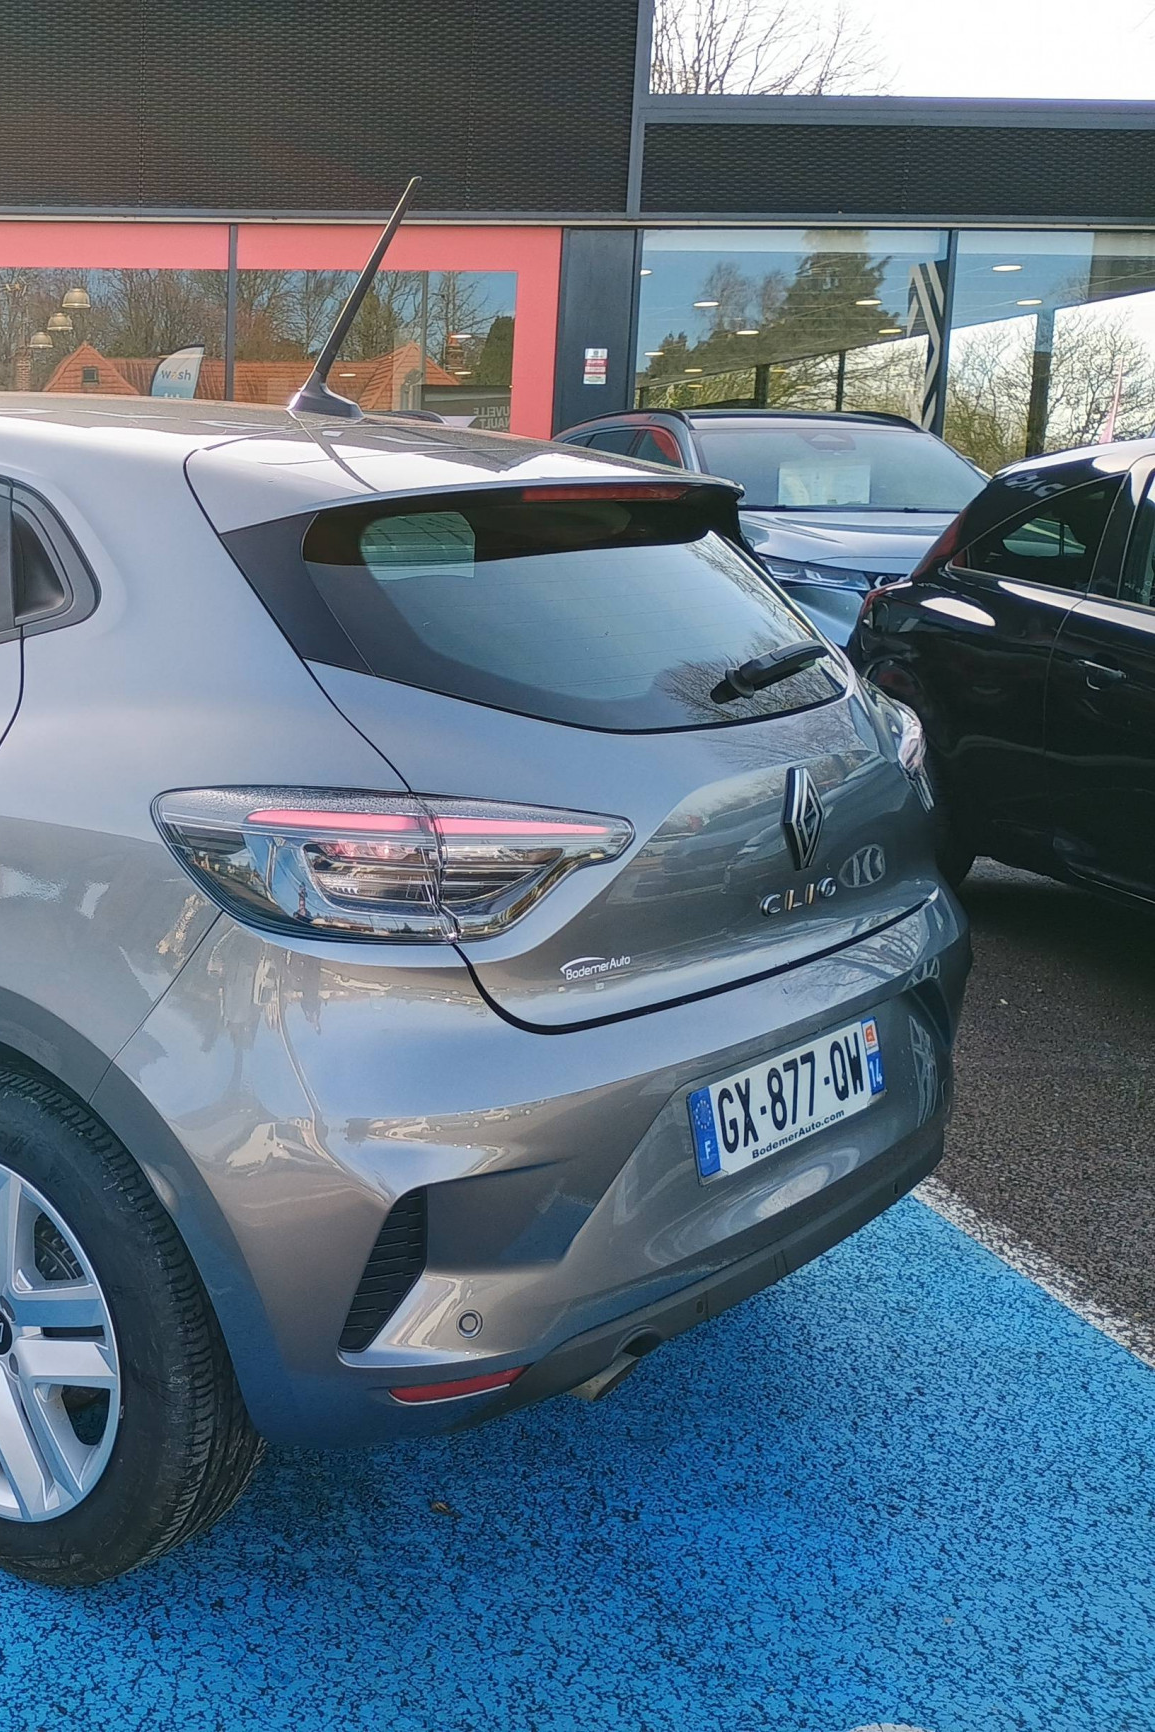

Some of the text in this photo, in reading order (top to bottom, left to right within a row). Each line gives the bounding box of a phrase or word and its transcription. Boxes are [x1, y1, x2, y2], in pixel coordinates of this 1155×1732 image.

[759, 877, 838, 917] CLIO
[566, 955, 631, 981] BodemerAuto
[869, 1060, 883, 1088] 14
[718, 1031, 865, 1154] GX-877-QW
[704, 1140, 712, 1160] F
[751, 1109, 845, 1160] BodemerAuto.com
